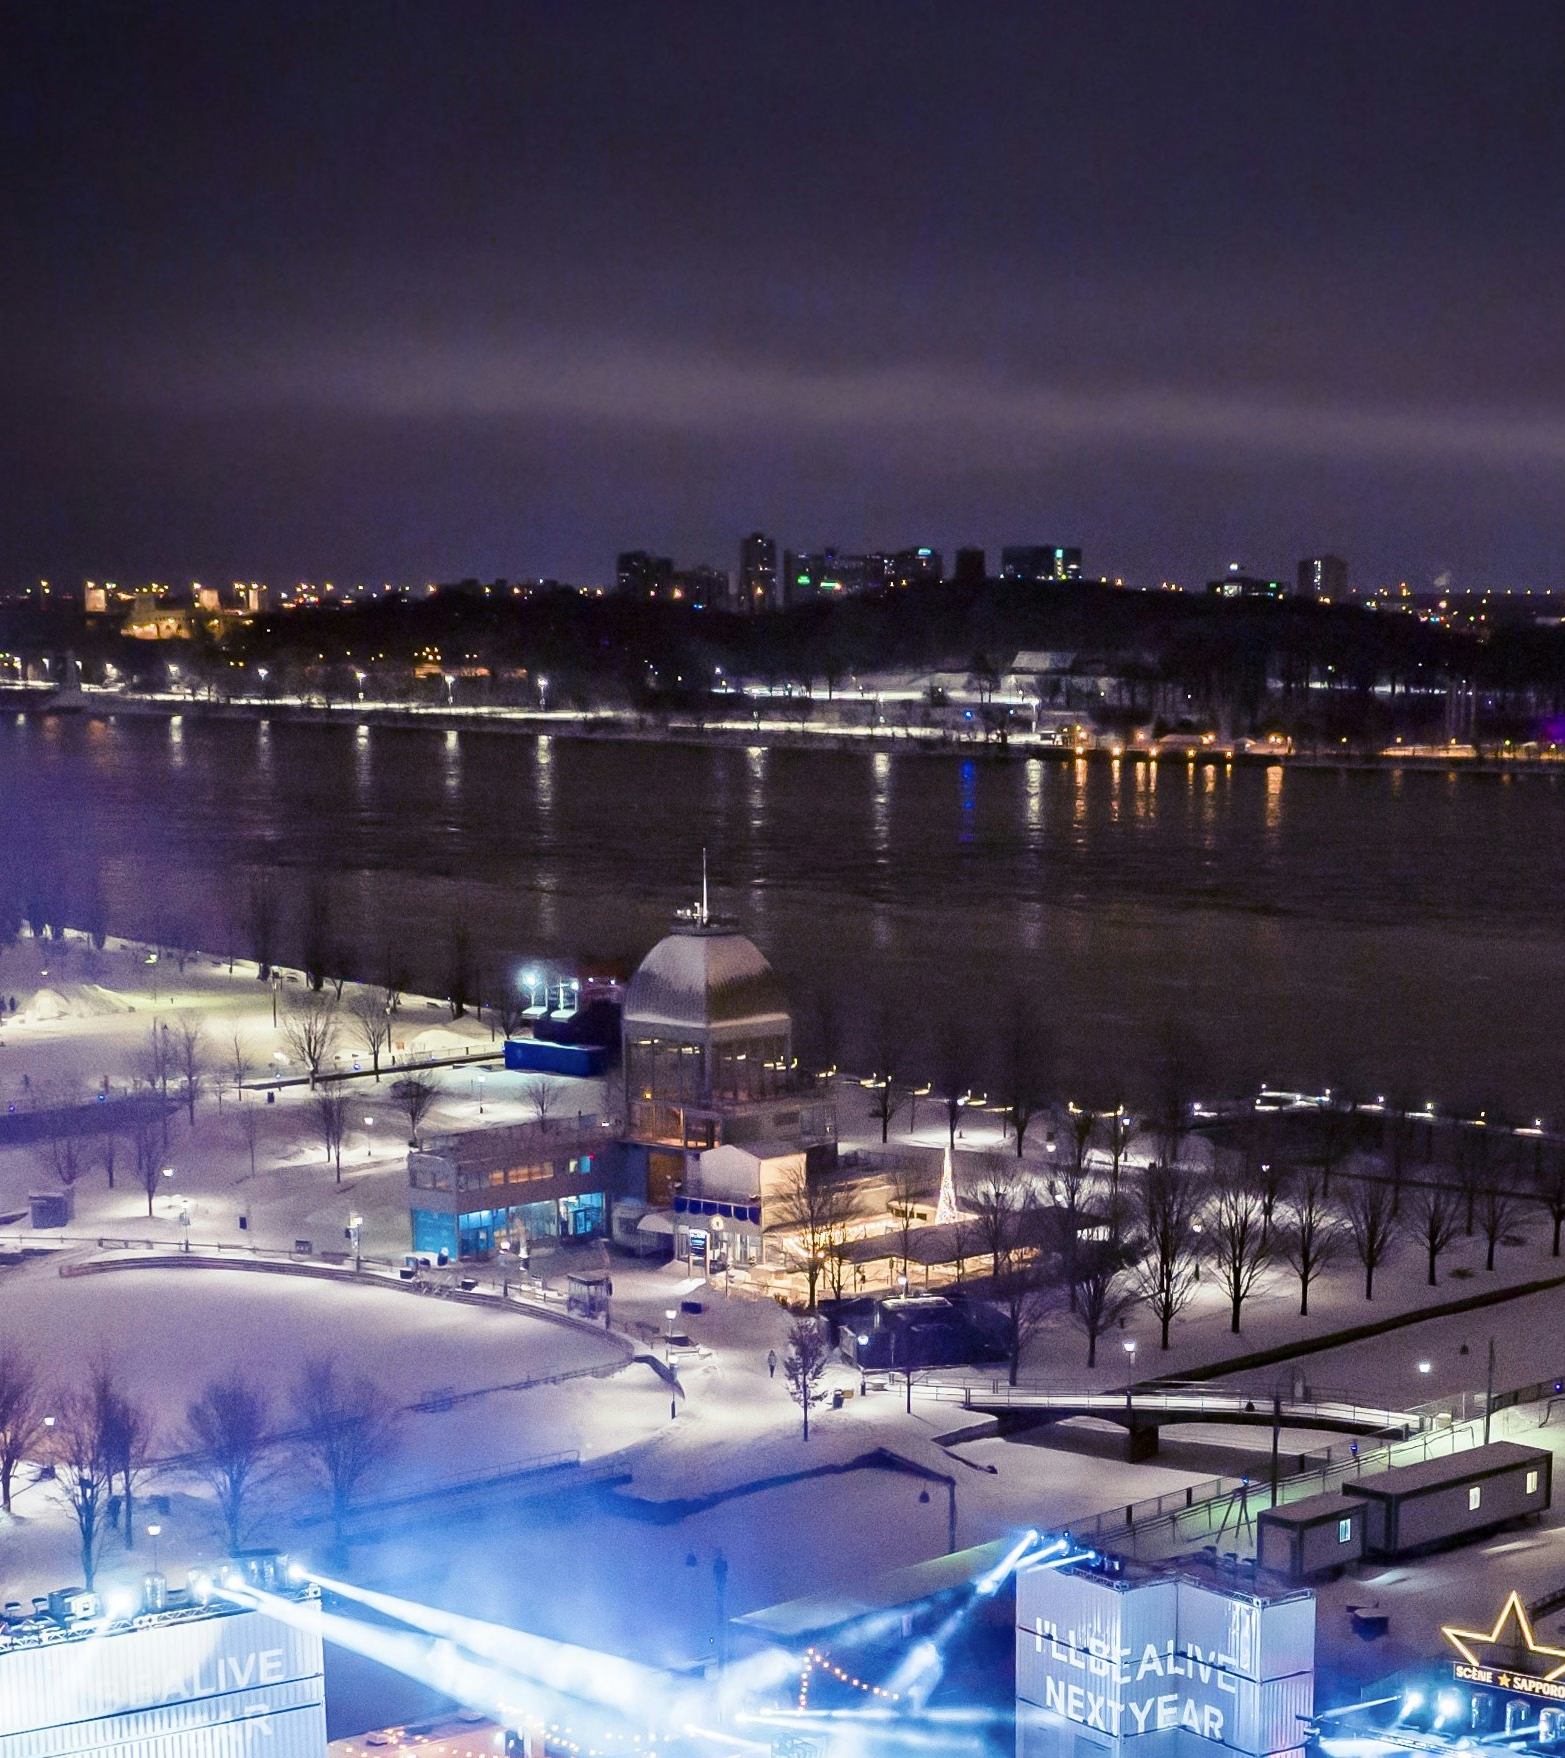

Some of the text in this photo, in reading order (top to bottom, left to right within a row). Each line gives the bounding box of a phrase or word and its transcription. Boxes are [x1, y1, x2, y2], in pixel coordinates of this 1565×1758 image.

[1456, 1666, 1565, 1699] SCÈNE SAPPORO
[1128, 1693, 1224, 1739] YEAR
